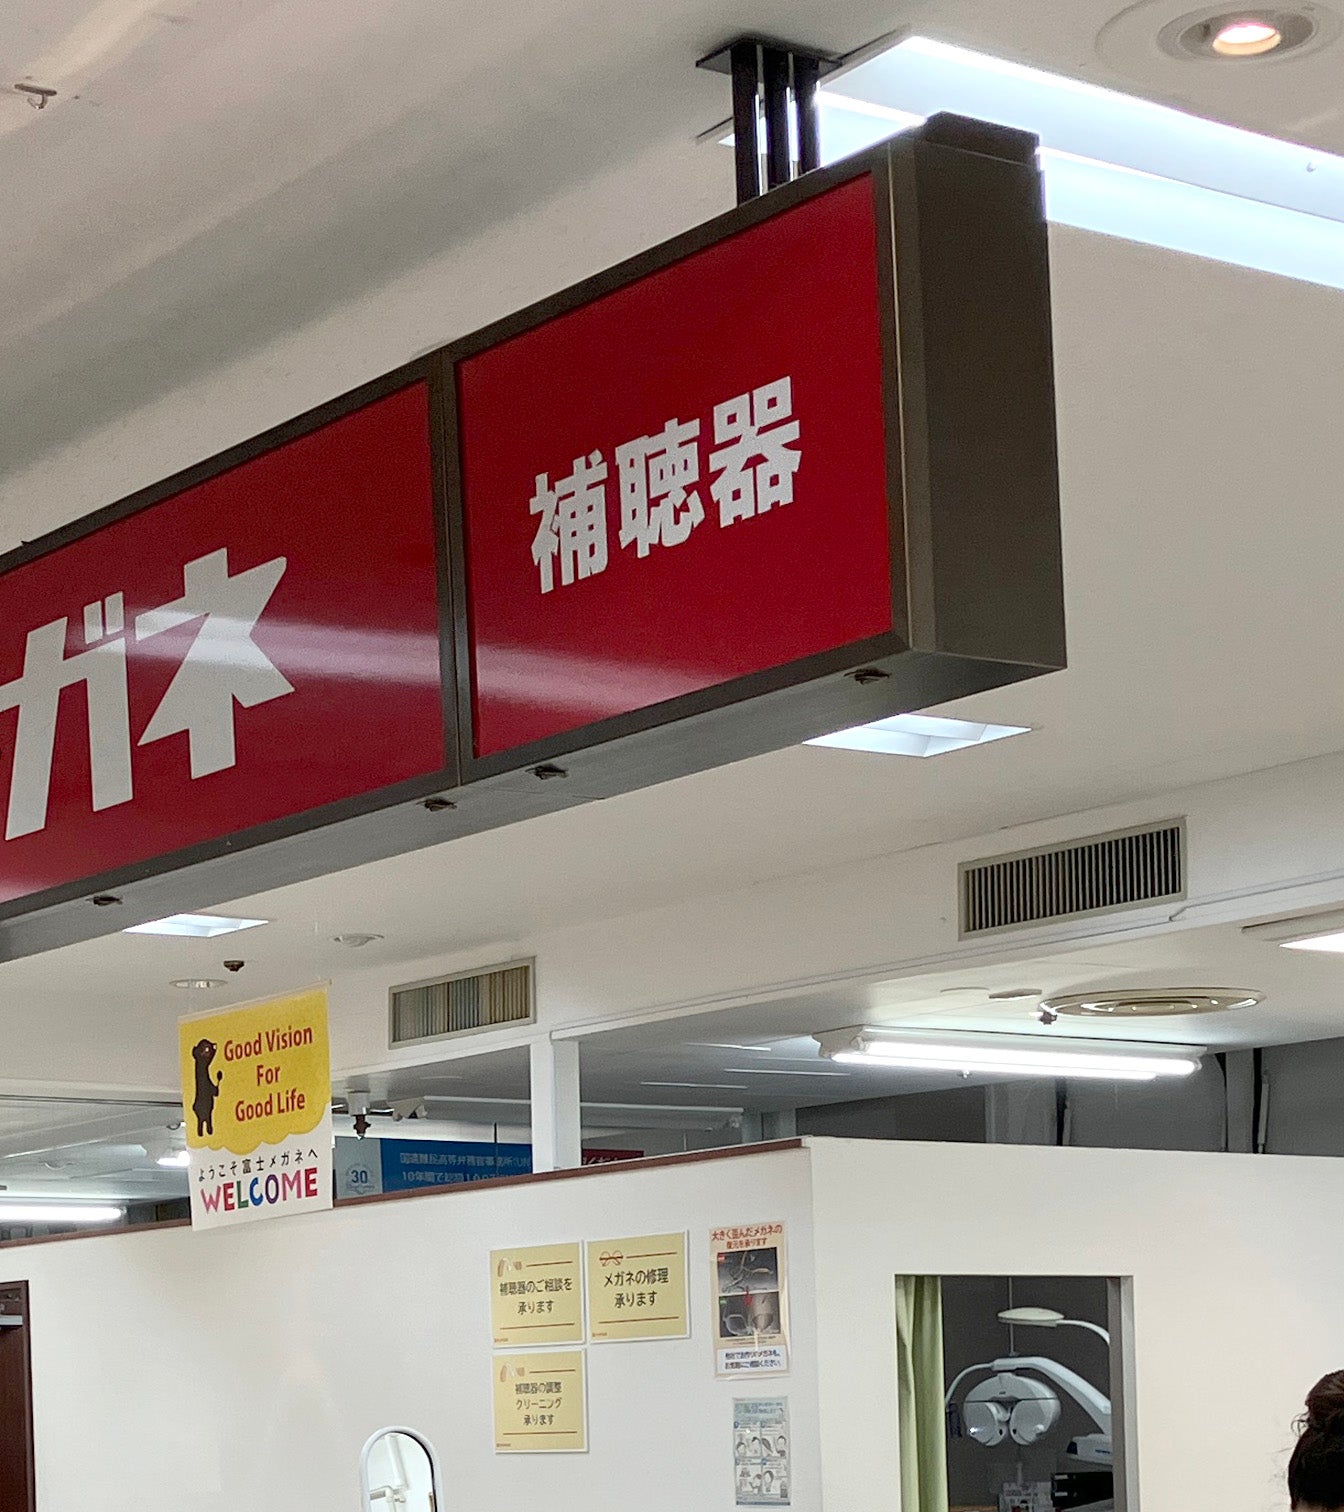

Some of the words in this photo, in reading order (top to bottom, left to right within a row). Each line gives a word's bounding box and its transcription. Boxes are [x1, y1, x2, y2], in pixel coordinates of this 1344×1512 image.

[529, 375, 802, 595] 補聴器
[224, 1032, 262, 1062] Good
[265, 1025, 313, 1053] Vision
[256, 1064, 281, 1087] For
[235, 1091, 273, 1122] Good
[277, 1087, 306, 1114] Life
[198, 1148, 319, 1182] ようこそ富士メガネへ
[351, 1170, 369, 1185] 30
[200, 1167, 319, 1214] WELCOME
[499, 1278, 573, 1297] 補聴器のご相談を
[604, 1267, 669, 1288] メガネの修理
[517, 1300, 554, 1315] 承ります
[614, 1290, 658, 1309] 承ります
[516, 1397, 562, 1410] クリーニング
[523, 1414, 555, 1426] 承ります
